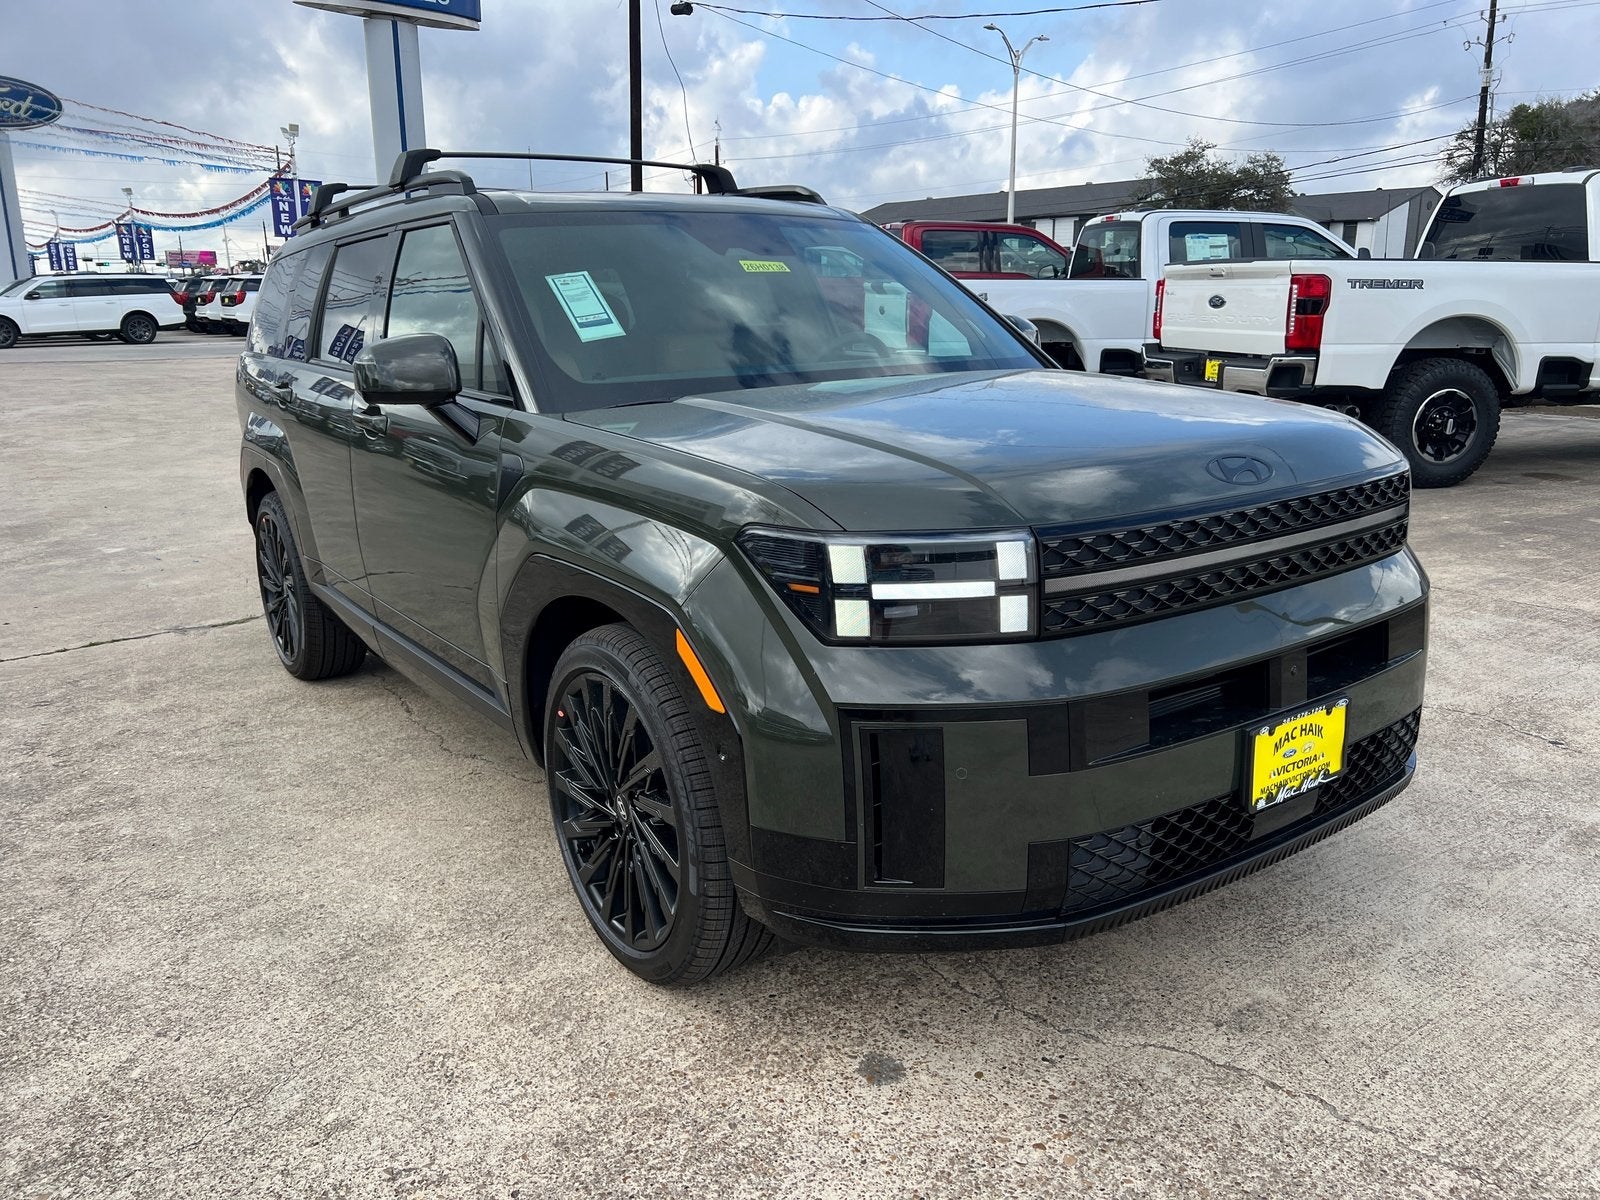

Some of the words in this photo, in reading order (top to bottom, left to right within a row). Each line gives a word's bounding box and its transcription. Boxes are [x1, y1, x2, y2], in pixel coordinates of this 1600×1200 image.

[278, 202, 292, 235] NEW
[122, 238, 132, 259] NEW
[142, 238, 151, 259] FORD
[1347, 279, 1425, 290] TREMOR
[1273, 727, 1298, 756] MAC
[1300, 723, 1324, 740] HAIK
[1276, 754, 1318, 777] VICTORIA
[1275, 786, 1300, 804] Mac
[1300, 768, 1337, 793] Haik
